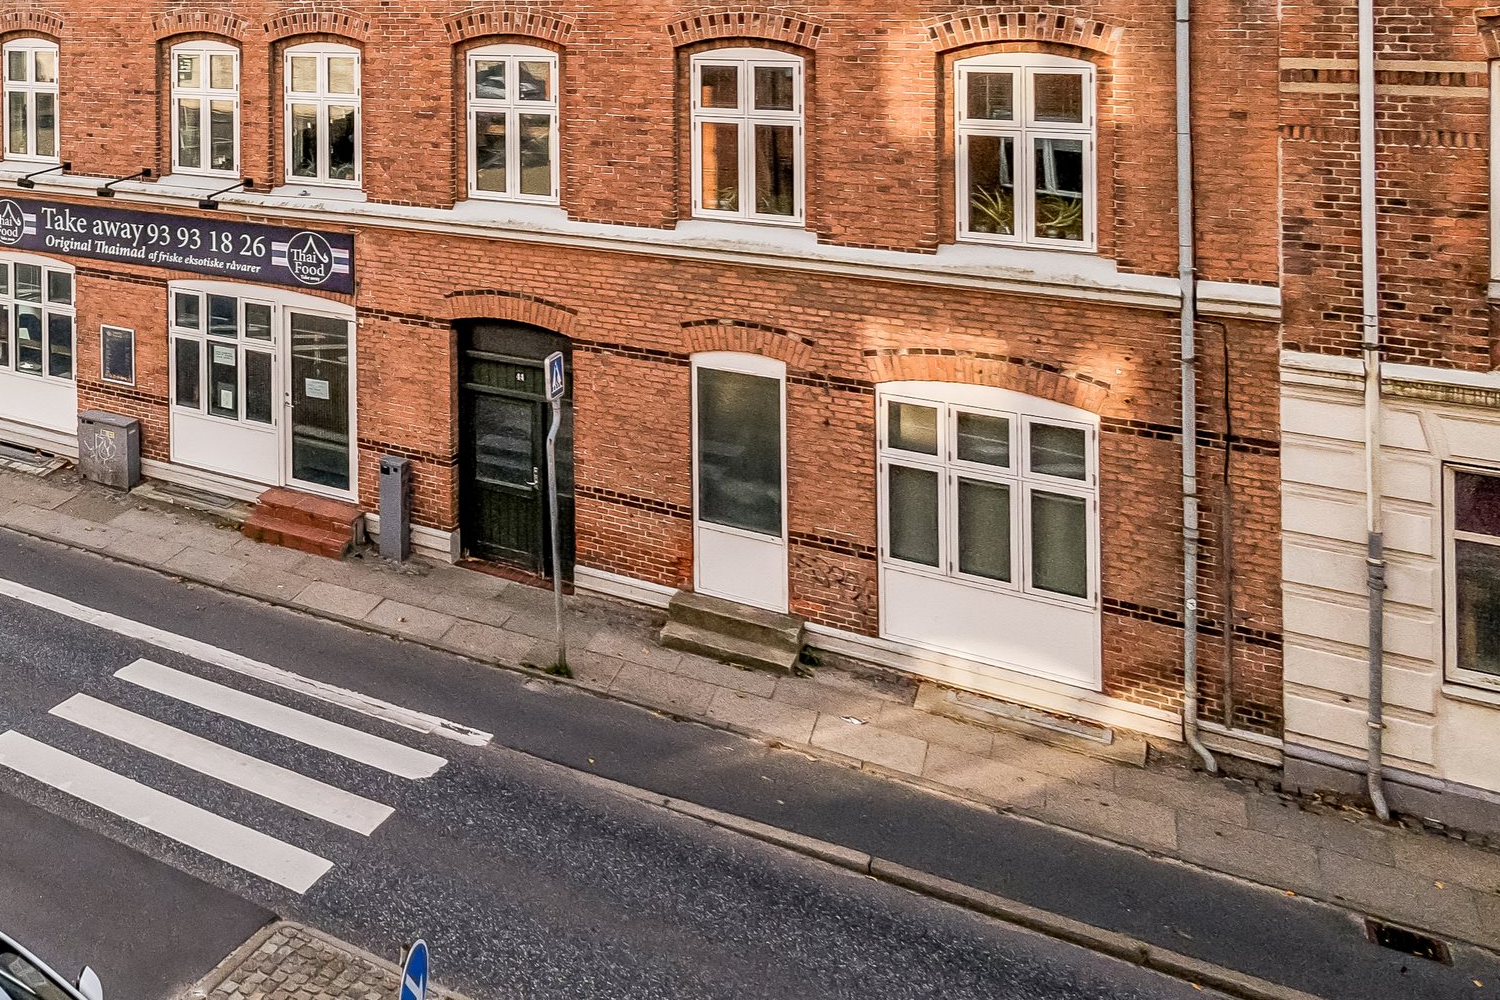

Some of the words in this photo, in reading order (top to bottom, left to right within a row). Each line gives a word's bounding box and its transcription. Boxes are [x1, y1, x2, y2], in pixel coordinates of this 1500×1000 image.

[41, 207, 87, 233] Take
[92, 219, 144, 247] away
[146, 223, 171, 246] 93
[177, 227, 201, 249] 93
[209, 230, 233, 254] 18
[239, 234, 266, 257] 26
[45, 234, 92, 253] Original
[94, 239, 146, 259] Thaimad
[157, 251, 183, 264] friske
[184, 254, 224, 269] eksotiske
[225, 260, 262, 274] råvarer
[290, 248, 317, 263] Thai
[294, 261, 325, 276] Food
